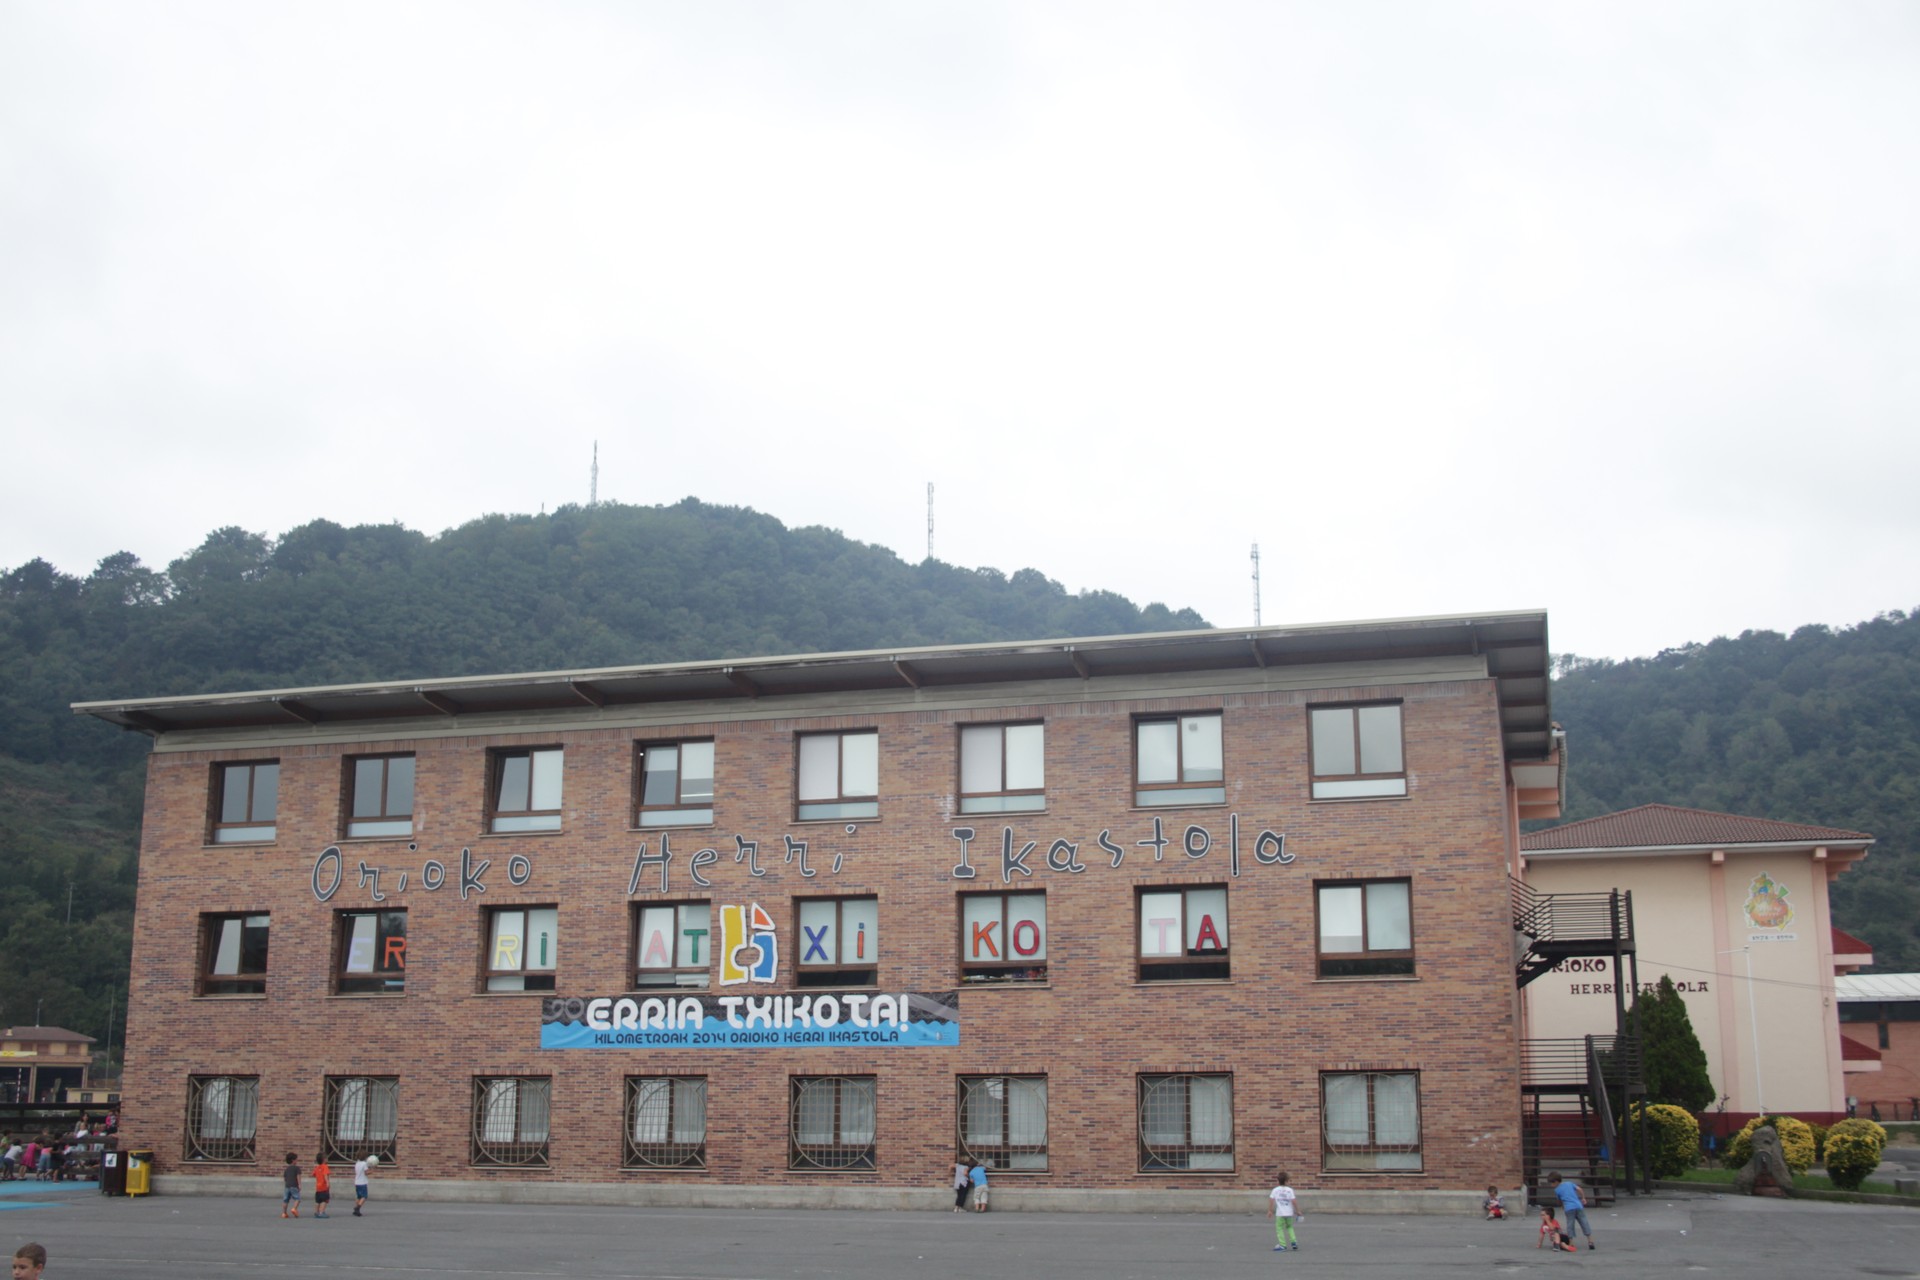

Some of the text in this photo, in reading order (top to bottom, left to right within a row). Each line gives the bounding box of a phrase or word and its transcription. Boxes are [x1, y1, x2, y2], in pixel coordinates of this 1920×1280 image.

[586, 994, 909, 1032] ERRIA TXIKOTA!
[595, 1030, 899, 1044] KILOMETROAK 2014 ORIOKO HERRI IKASTOLA
